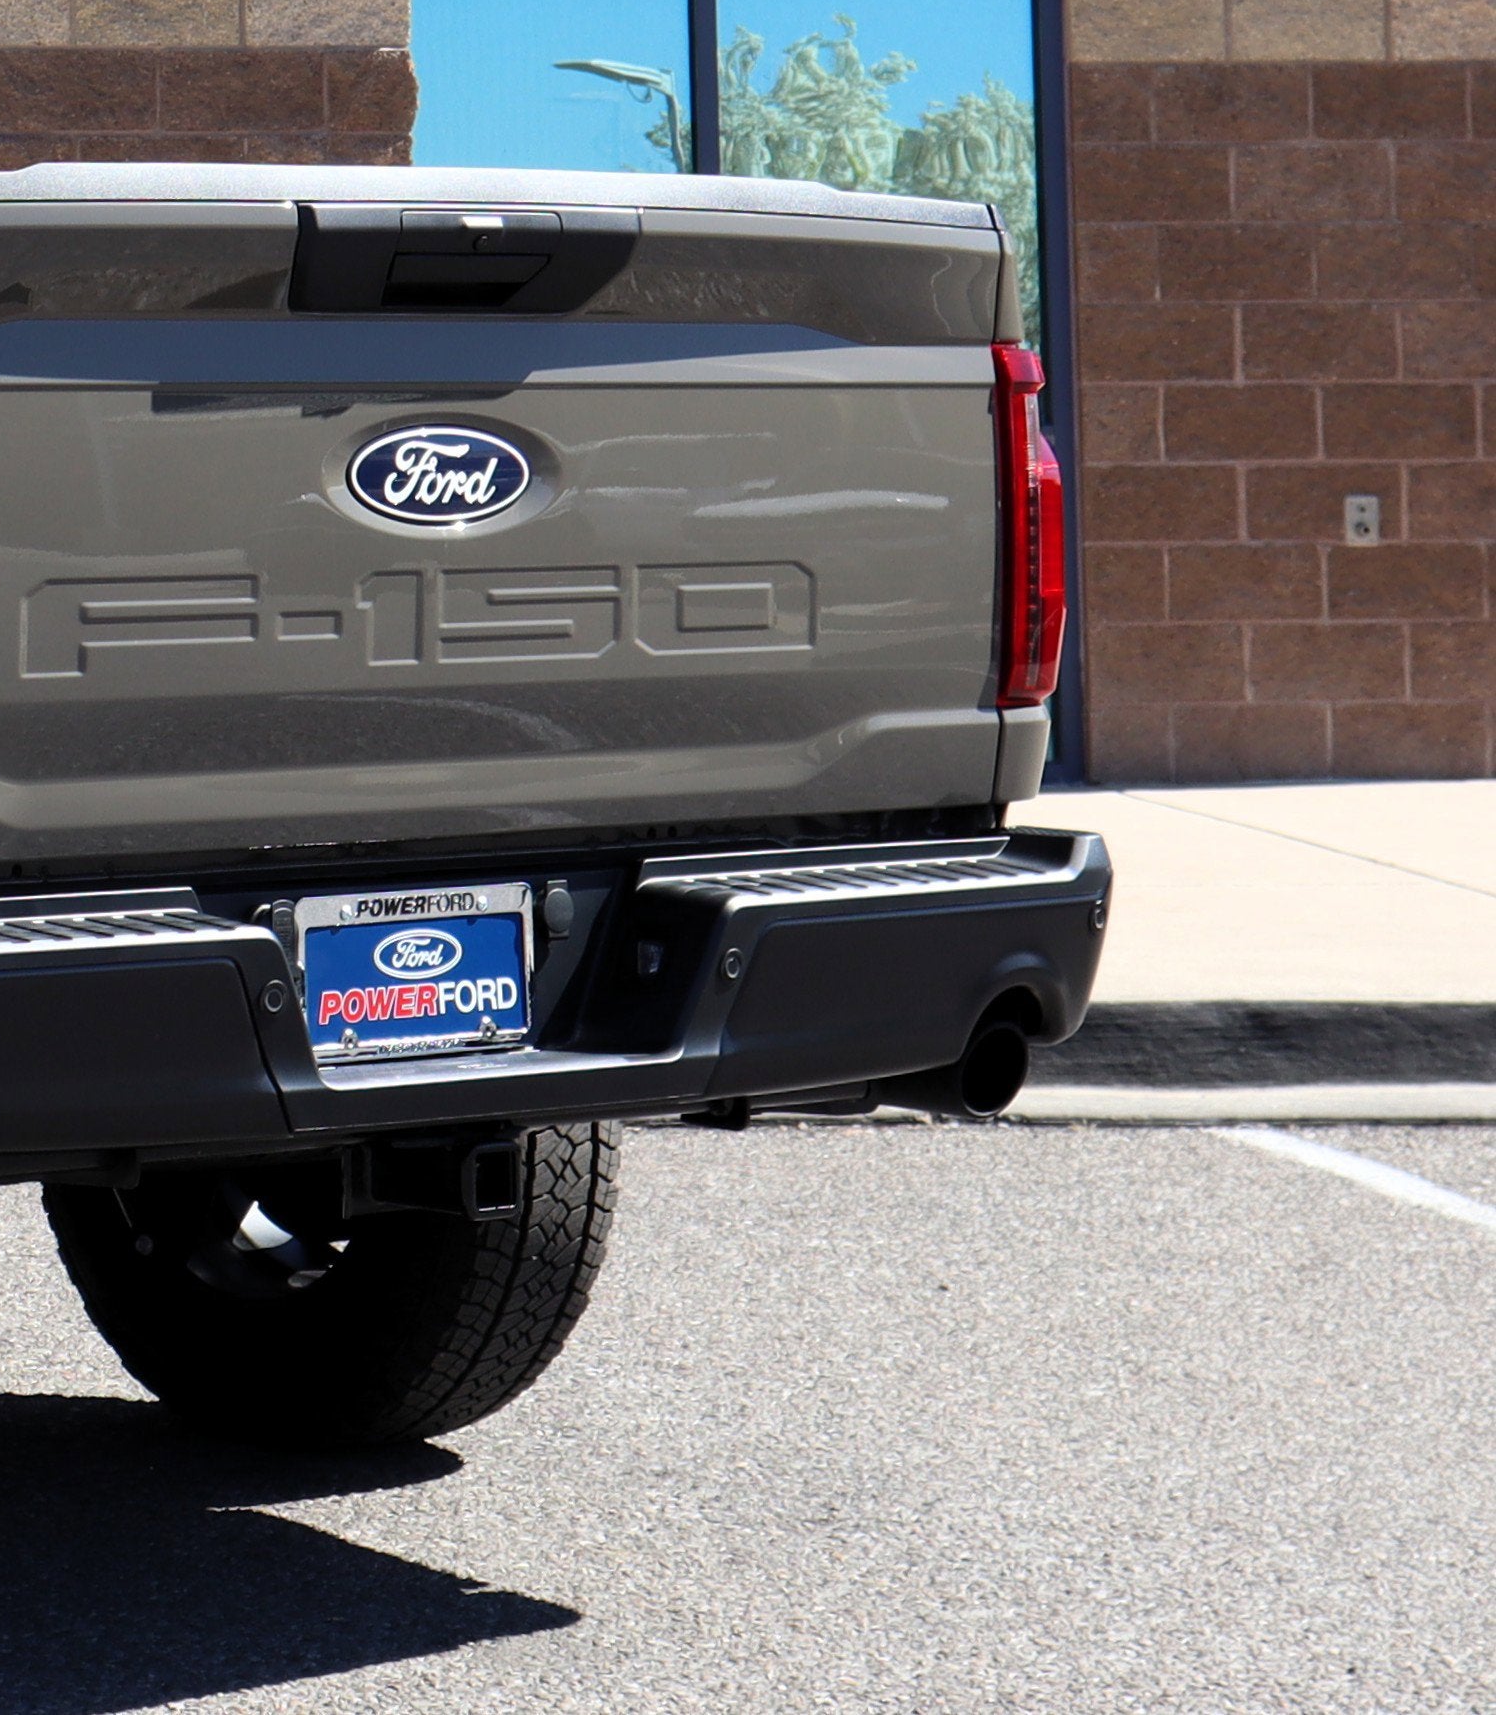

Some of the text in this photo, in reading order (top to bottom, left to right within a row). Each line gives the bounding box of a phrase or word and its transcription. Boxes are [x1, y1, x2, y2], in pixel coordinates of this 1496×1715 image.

[383, 440, 499, 508] Ford
[19, 560, 817, 679] F-150
[392, 938, 444, 969] Ford
